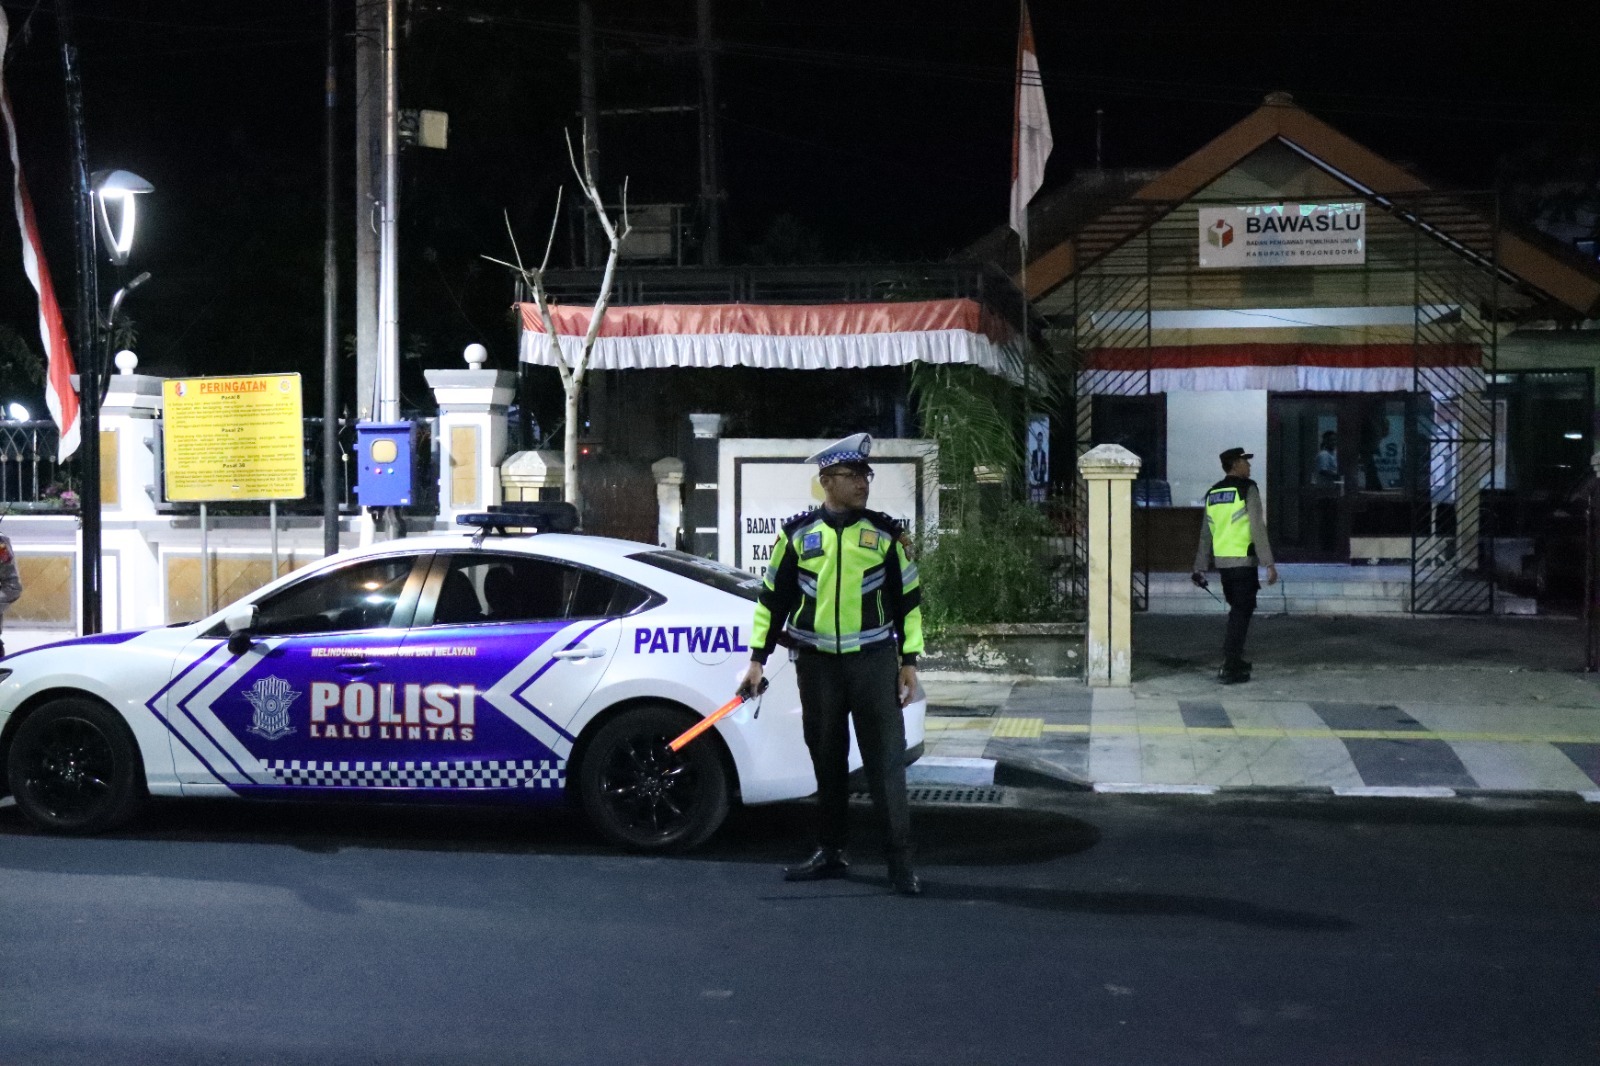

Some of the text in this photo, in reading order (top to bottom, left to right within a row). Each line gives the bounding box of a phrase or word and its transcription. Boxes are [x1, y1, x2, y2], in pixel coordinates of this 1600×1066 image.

[1246, 214, 1360, 234] BAWASLU
[1300, 248, 1359, 256] BOJONEGORO
[200, 380, 267, 393] PERINGATAN
[746, 518, 776, 534] BADAN
[634, 626, 748, 654] PATWAL
[435, 646, 477, 657] MELAYANI
[311, 682, 476, 725] POLISI
[311, 725, 474, 741] LALU LINTAS
